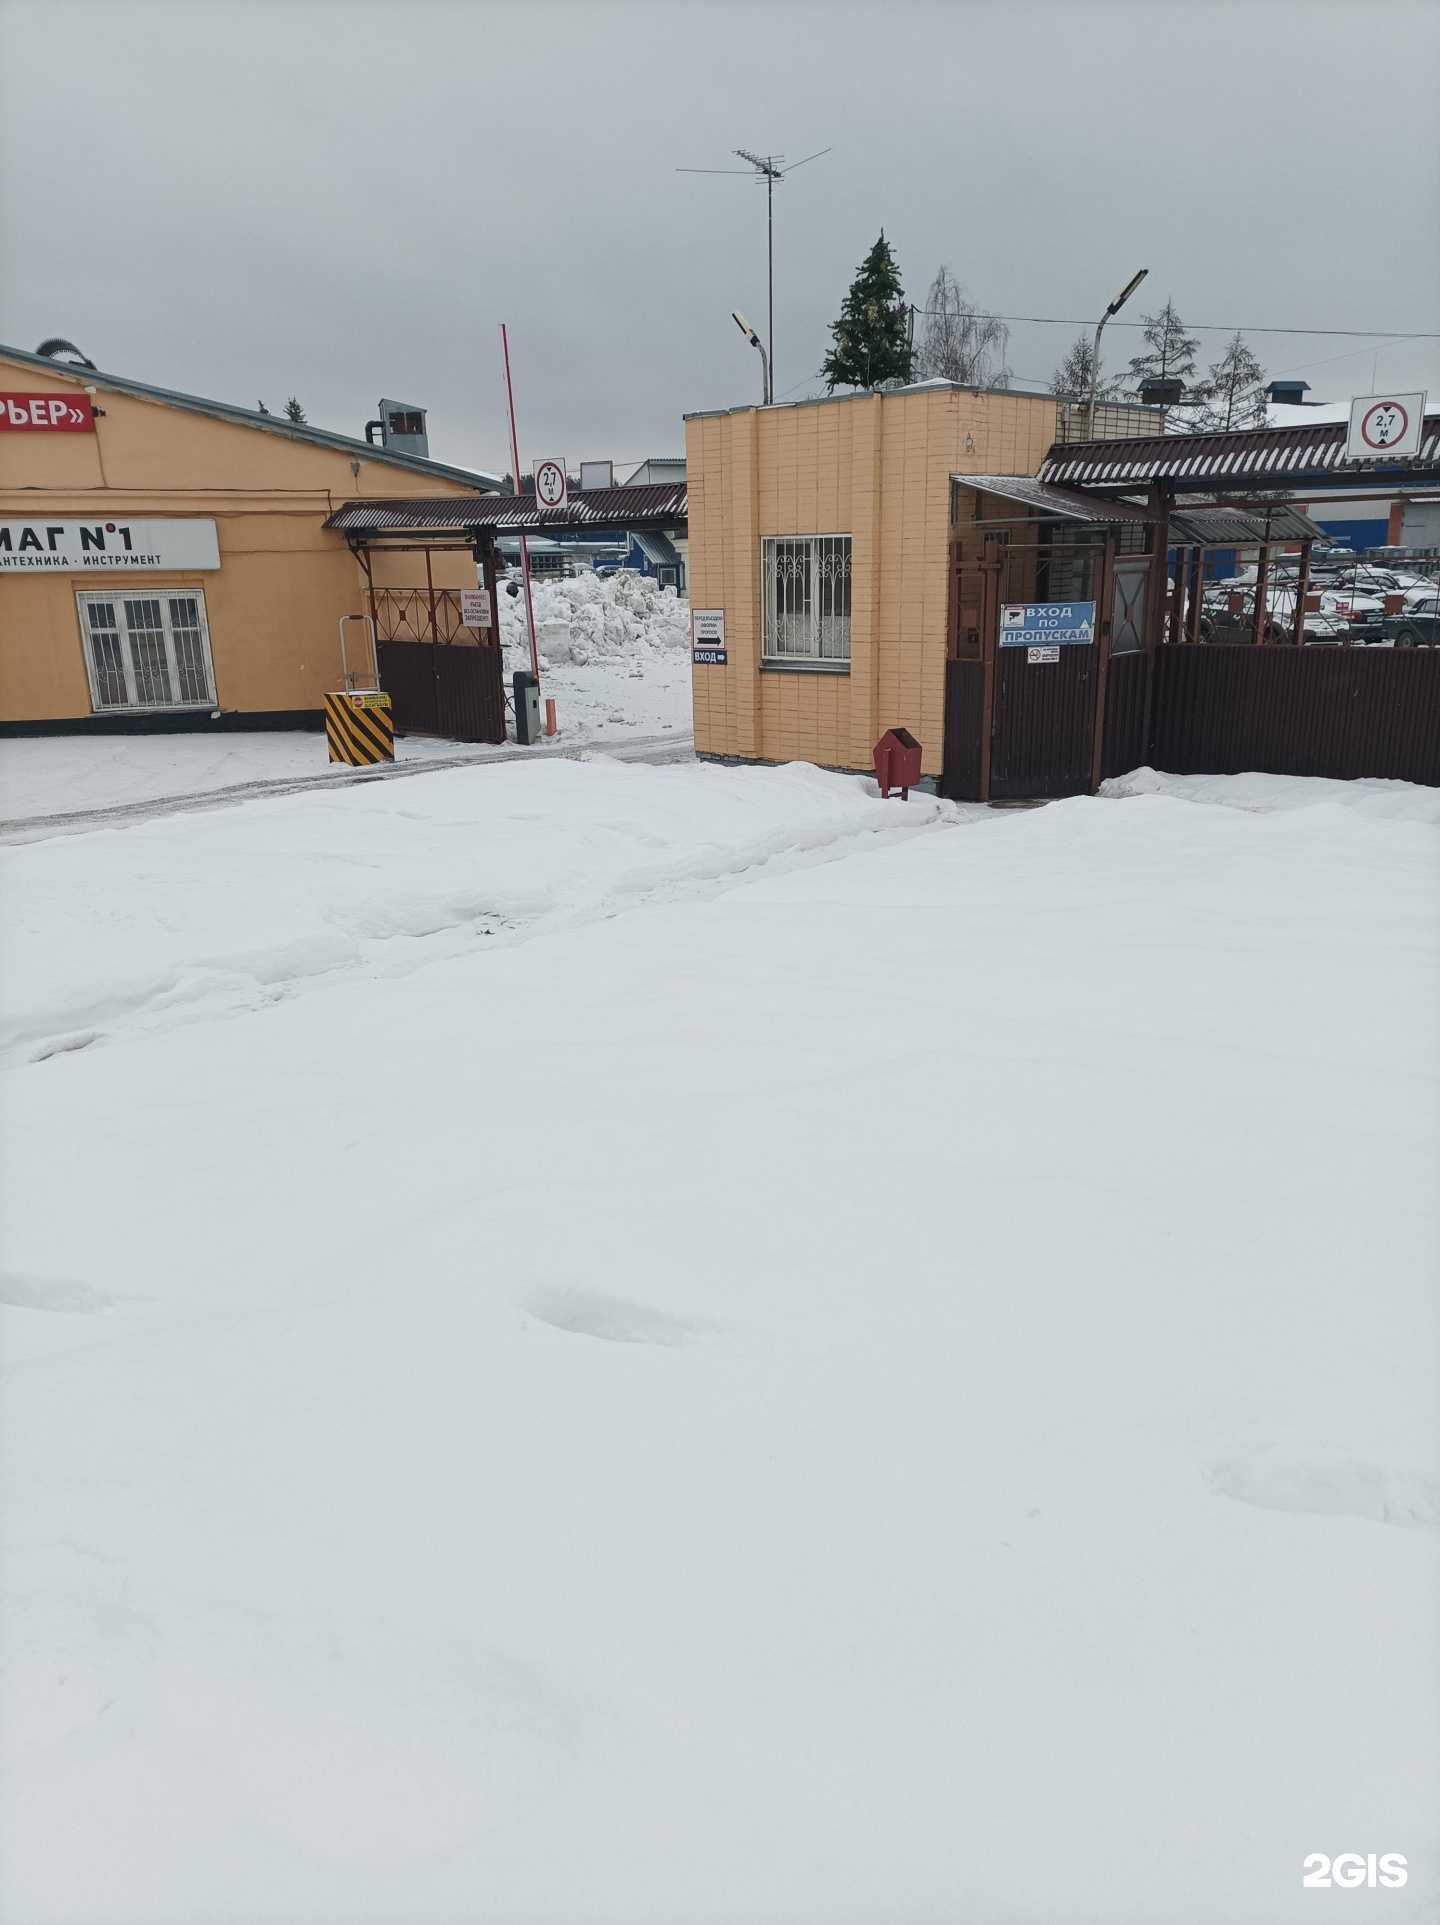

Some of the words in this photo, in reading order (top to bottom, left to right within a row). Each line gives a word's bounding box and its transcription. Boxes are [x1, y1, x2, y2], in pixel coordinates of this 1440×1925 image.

[0, 400, 84, 425] ЬЕР»
[1376, 415, 1395, 428] 2,7
[543, 472, 556, 487] 2,7
[83, 555, 161, 566] ИНСТРУМЕНТ
[1026, 607, 1072, 618] ВХОД
[1038, 619, 1058, 627] ПО
[1005, 630, 1088, 641] ПРОПУСКАМ
[694, 651, 716, 663] ВХОД
